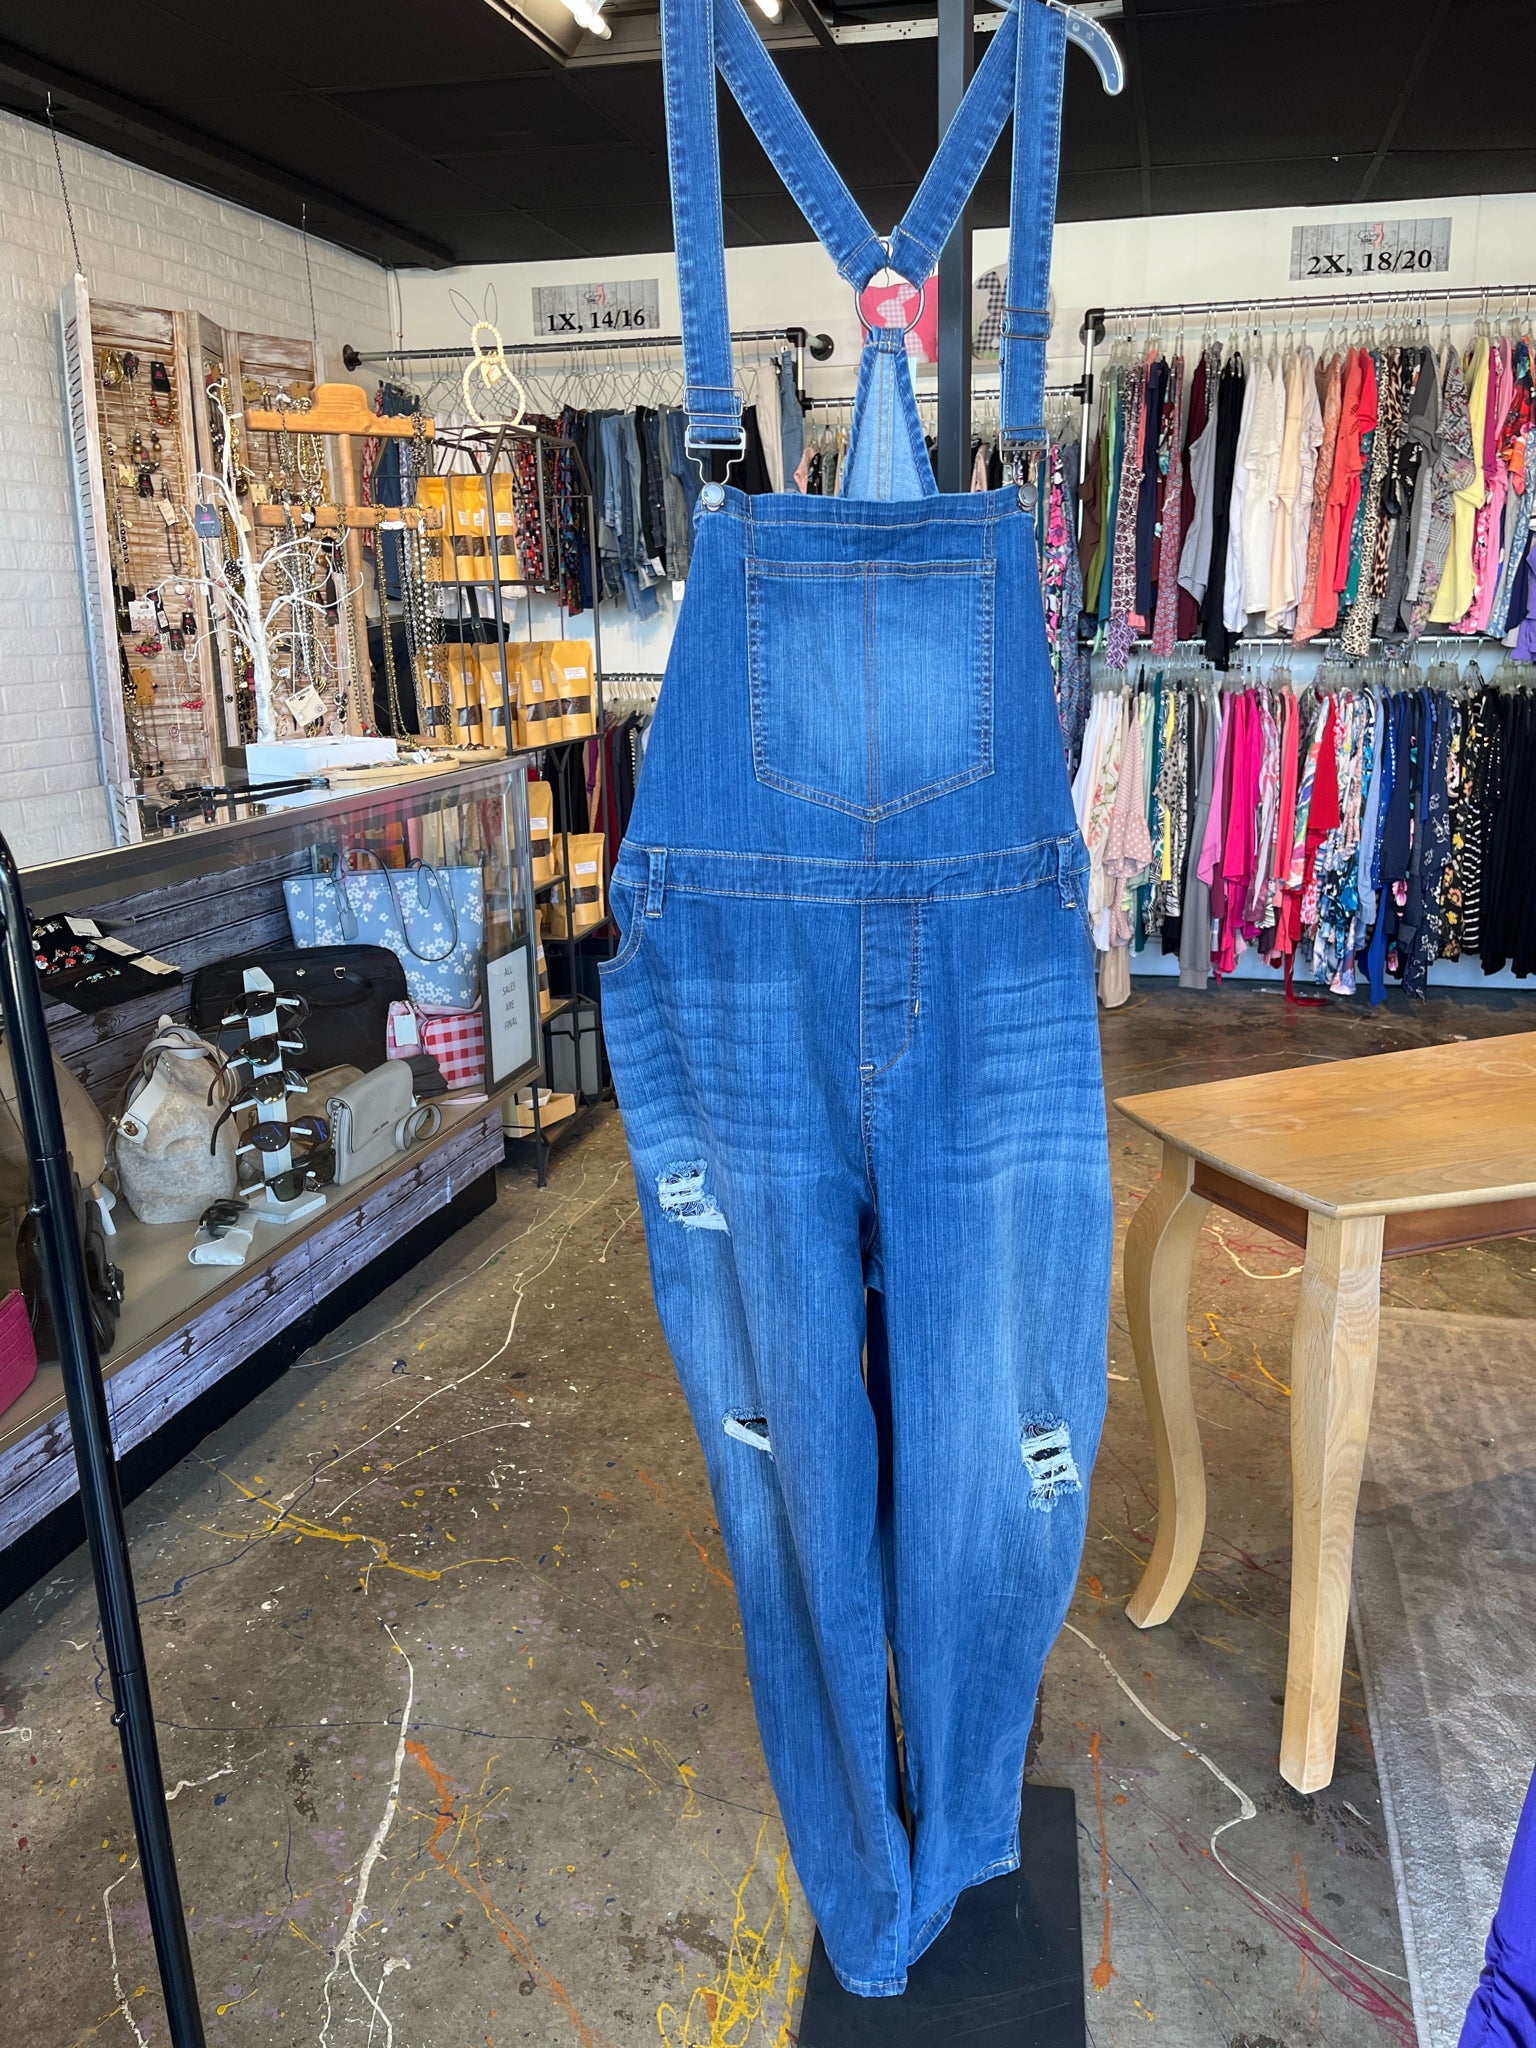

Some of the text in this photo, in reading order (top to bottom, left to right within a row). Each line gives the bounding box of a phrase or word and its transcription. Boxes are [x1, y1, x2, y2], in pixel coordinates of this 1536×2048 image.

[1307, 249, 1432, 276] 2X, 18/20
[547, 308, 645, 333] 1X, 14/16
[503, 966, 513, 977] ALL
[502, 981, 516, 996] SALES
[505, 1000, 515, 1011] ARE
[504, 1017, 518, 1031] FINAL
